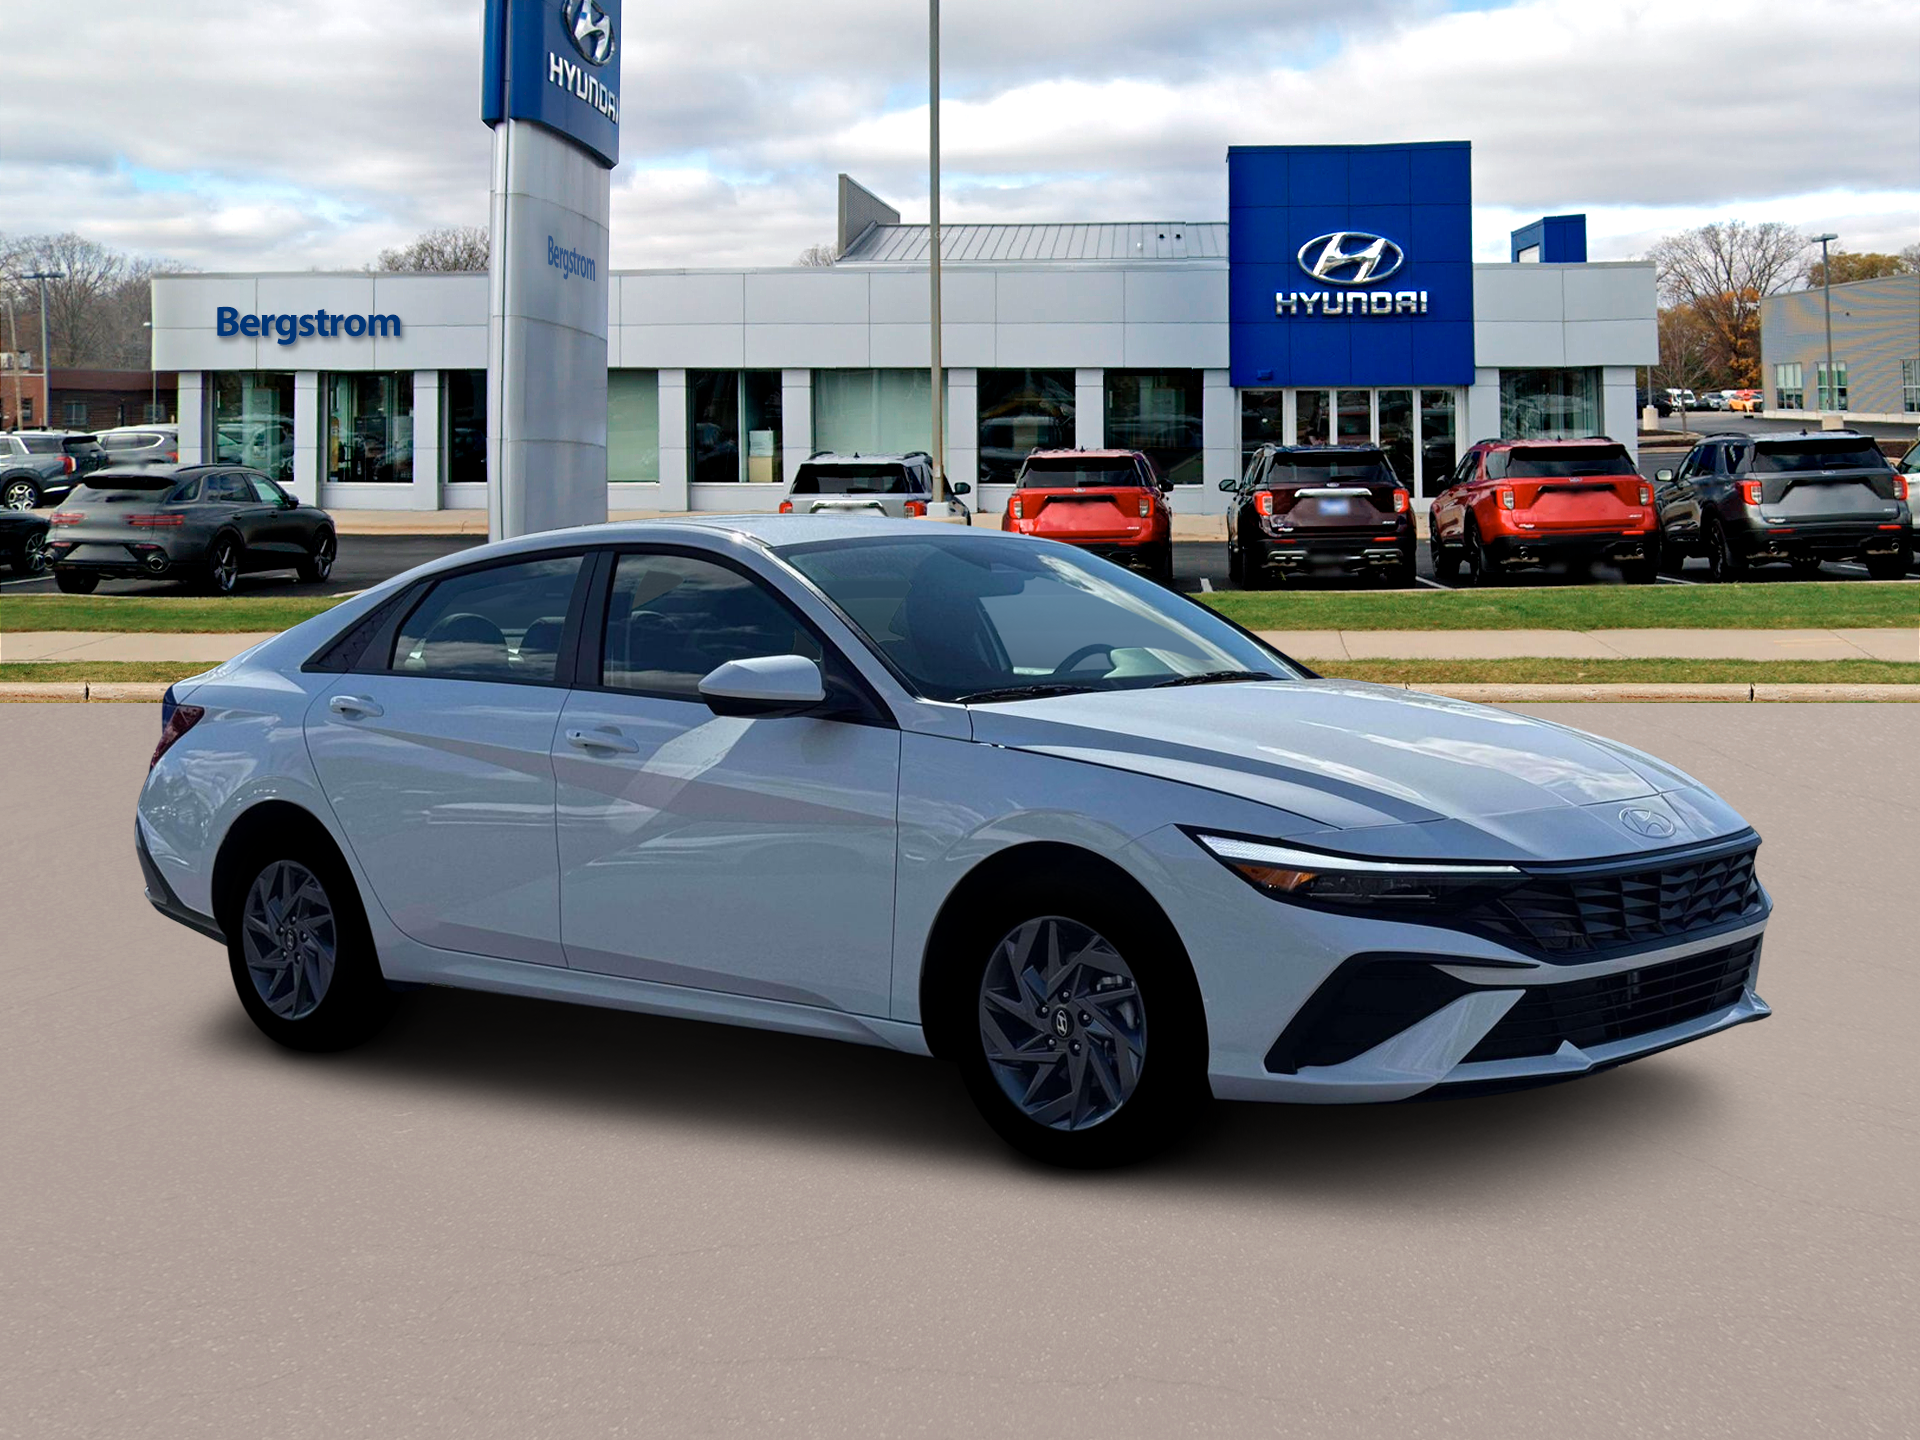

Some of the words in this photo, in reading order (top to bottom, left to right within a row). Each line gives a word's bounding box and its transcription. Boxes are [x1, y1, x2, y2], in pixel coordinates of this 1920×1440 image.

[549, 52, 619, 124] HYUNDAI
[547, 235, 596, 282] Bergstrom
[1275, 291, 1429, 316] HYUNDAI
[217, 306, 401, 345] Bergstrom
